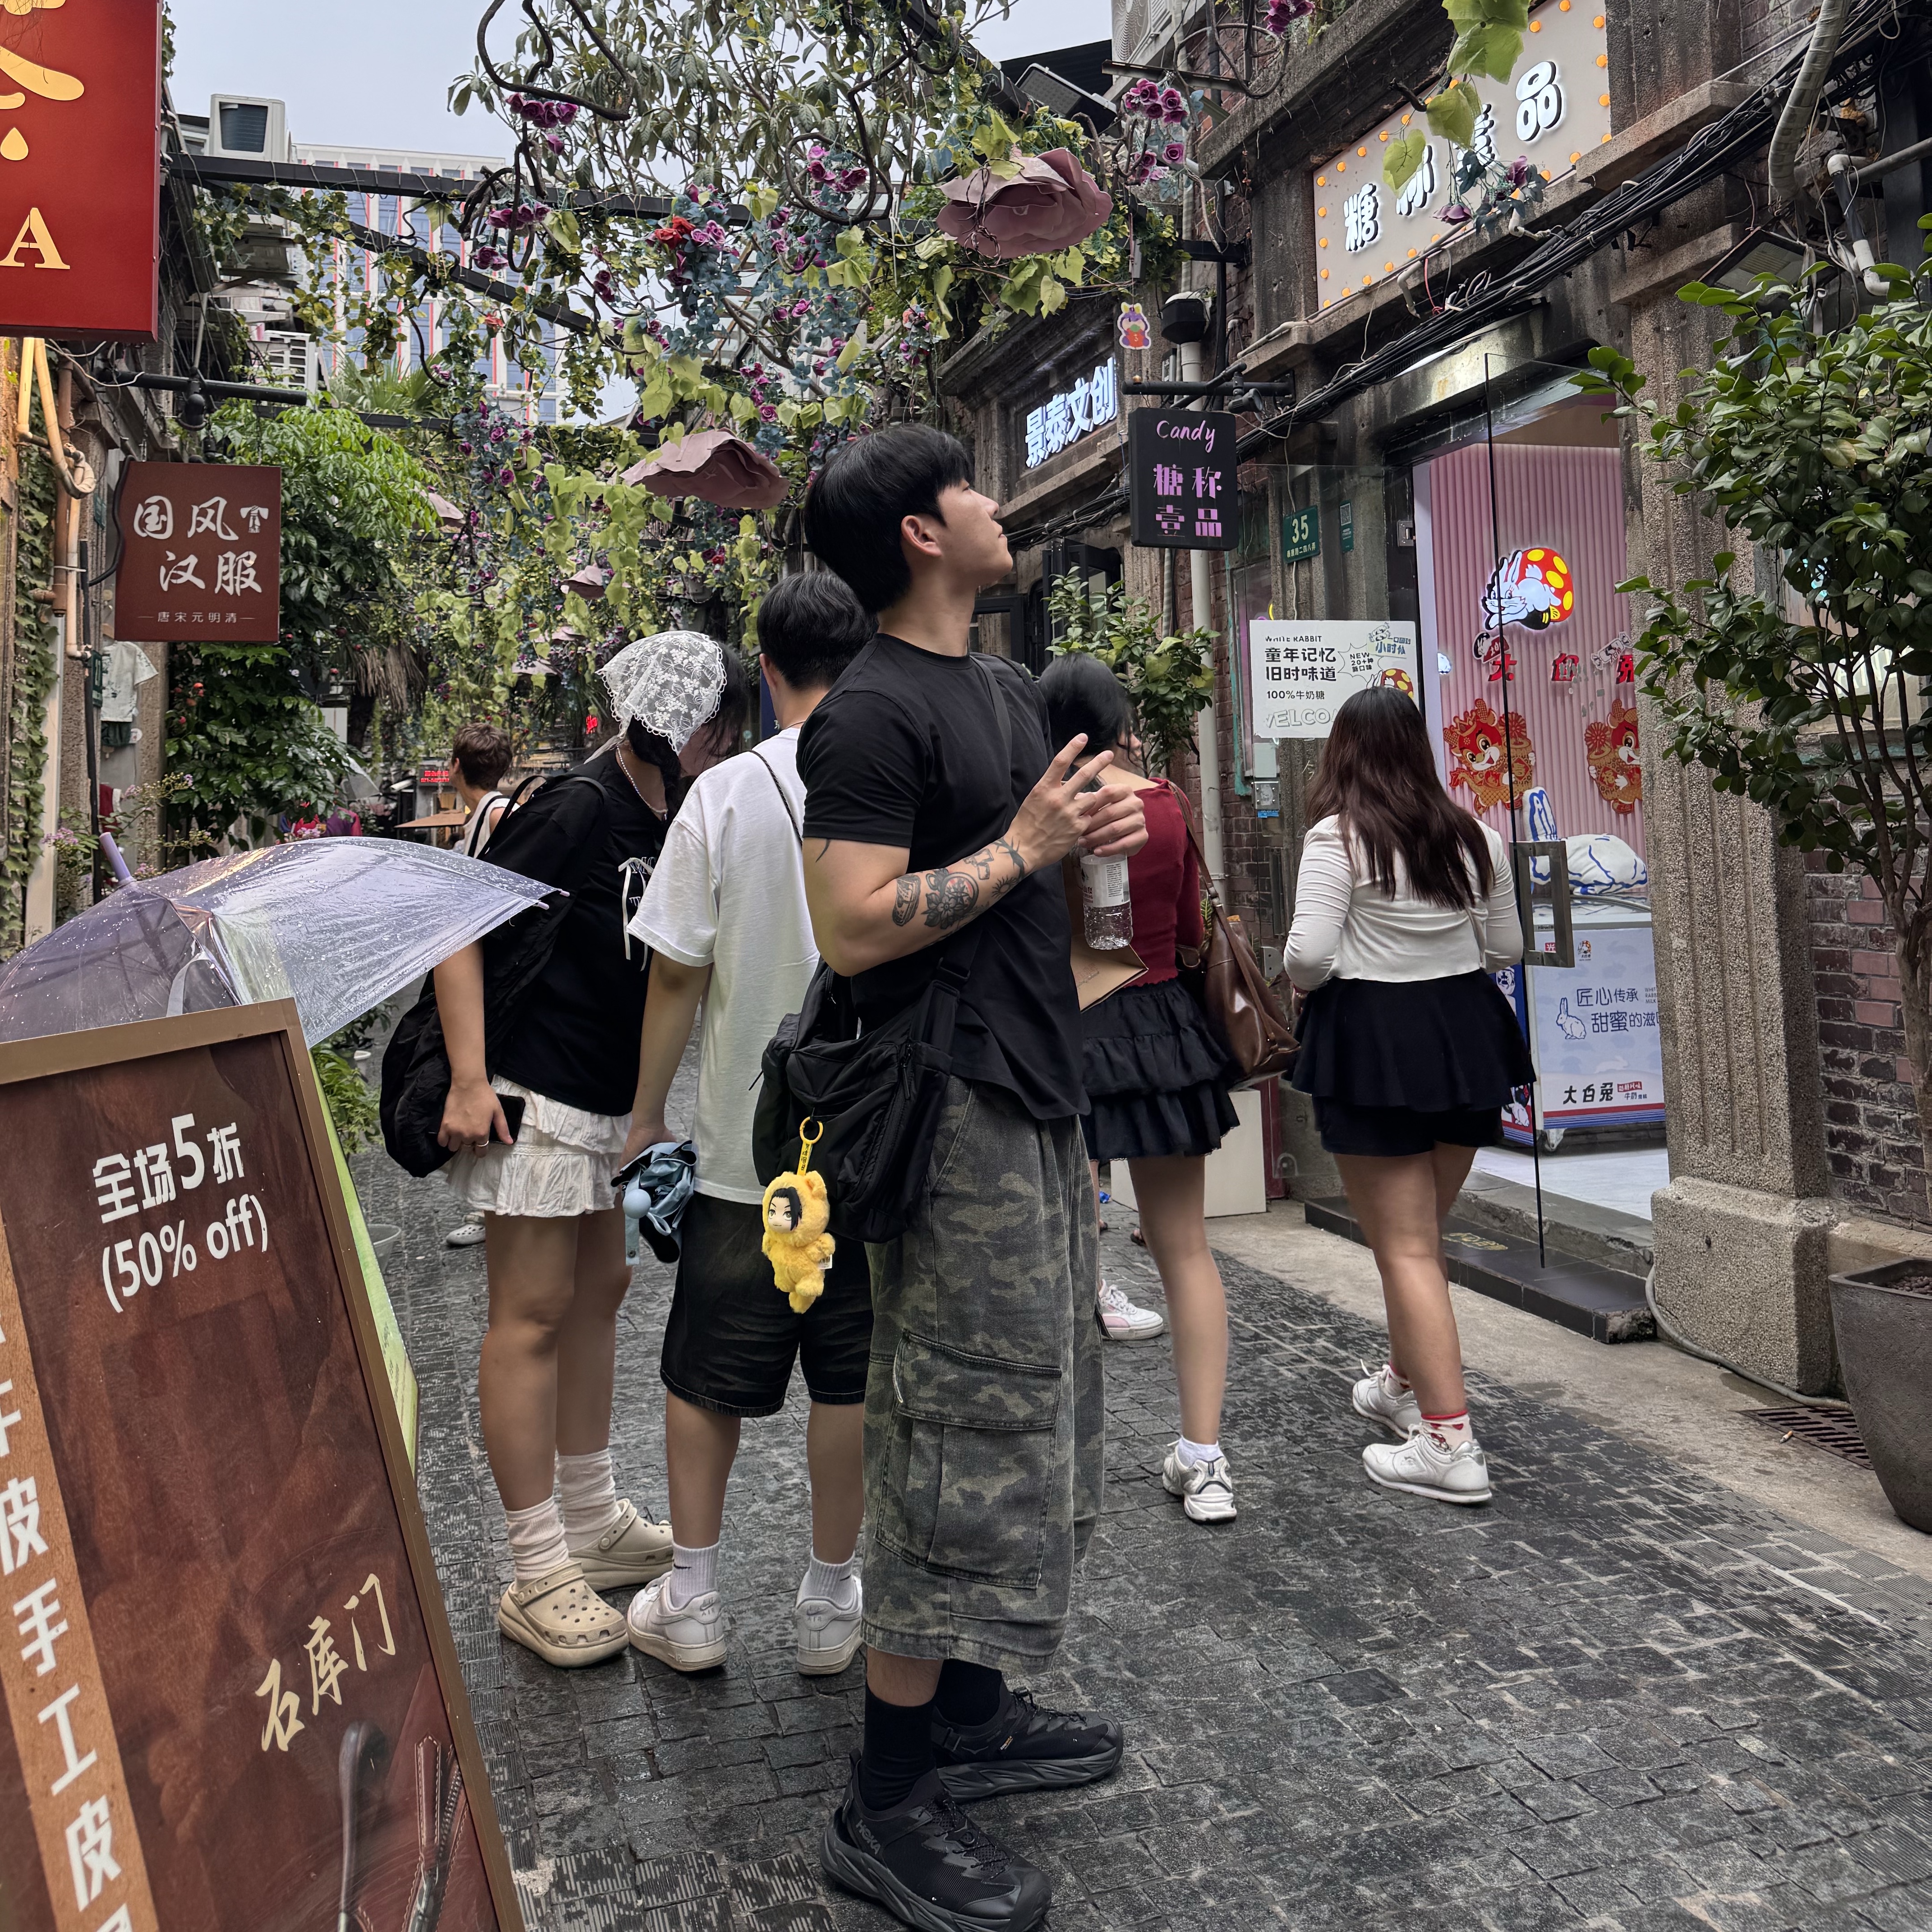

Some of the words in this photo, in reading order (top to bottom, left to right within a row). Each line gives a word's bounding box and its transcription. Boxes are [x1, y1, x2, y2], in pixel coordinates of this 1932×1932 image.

[1025, 357, 1117, 469] 景泰文创
[1156, 420, 1215, 453] Candy
[134, 495, 239, 540] 国风
[1292, 515, 1309, 543] 35
[159, 551, 262, 596] 汉服
[157, 611, 237, 623] 唐宋元明清
[1265, 647, 1337, 662] 童年记忆
[1266, 666, 1337, 681] 旧时味道
[1267, 690, 1325, 700] 100%牛奶糖
[1577, 986, 1638, 1007] 匠心传承
[1563, 1082, 1614, 1105] 大白兔
[92, 1113, 244, 1224] 全场5折
[102, 1219, 197, 1313] (50%
[207, 1194, 268, 1260] off)
[256, 1573, 396, 1752] 石库门
[856, 1819, 881, 1855] HOKA
